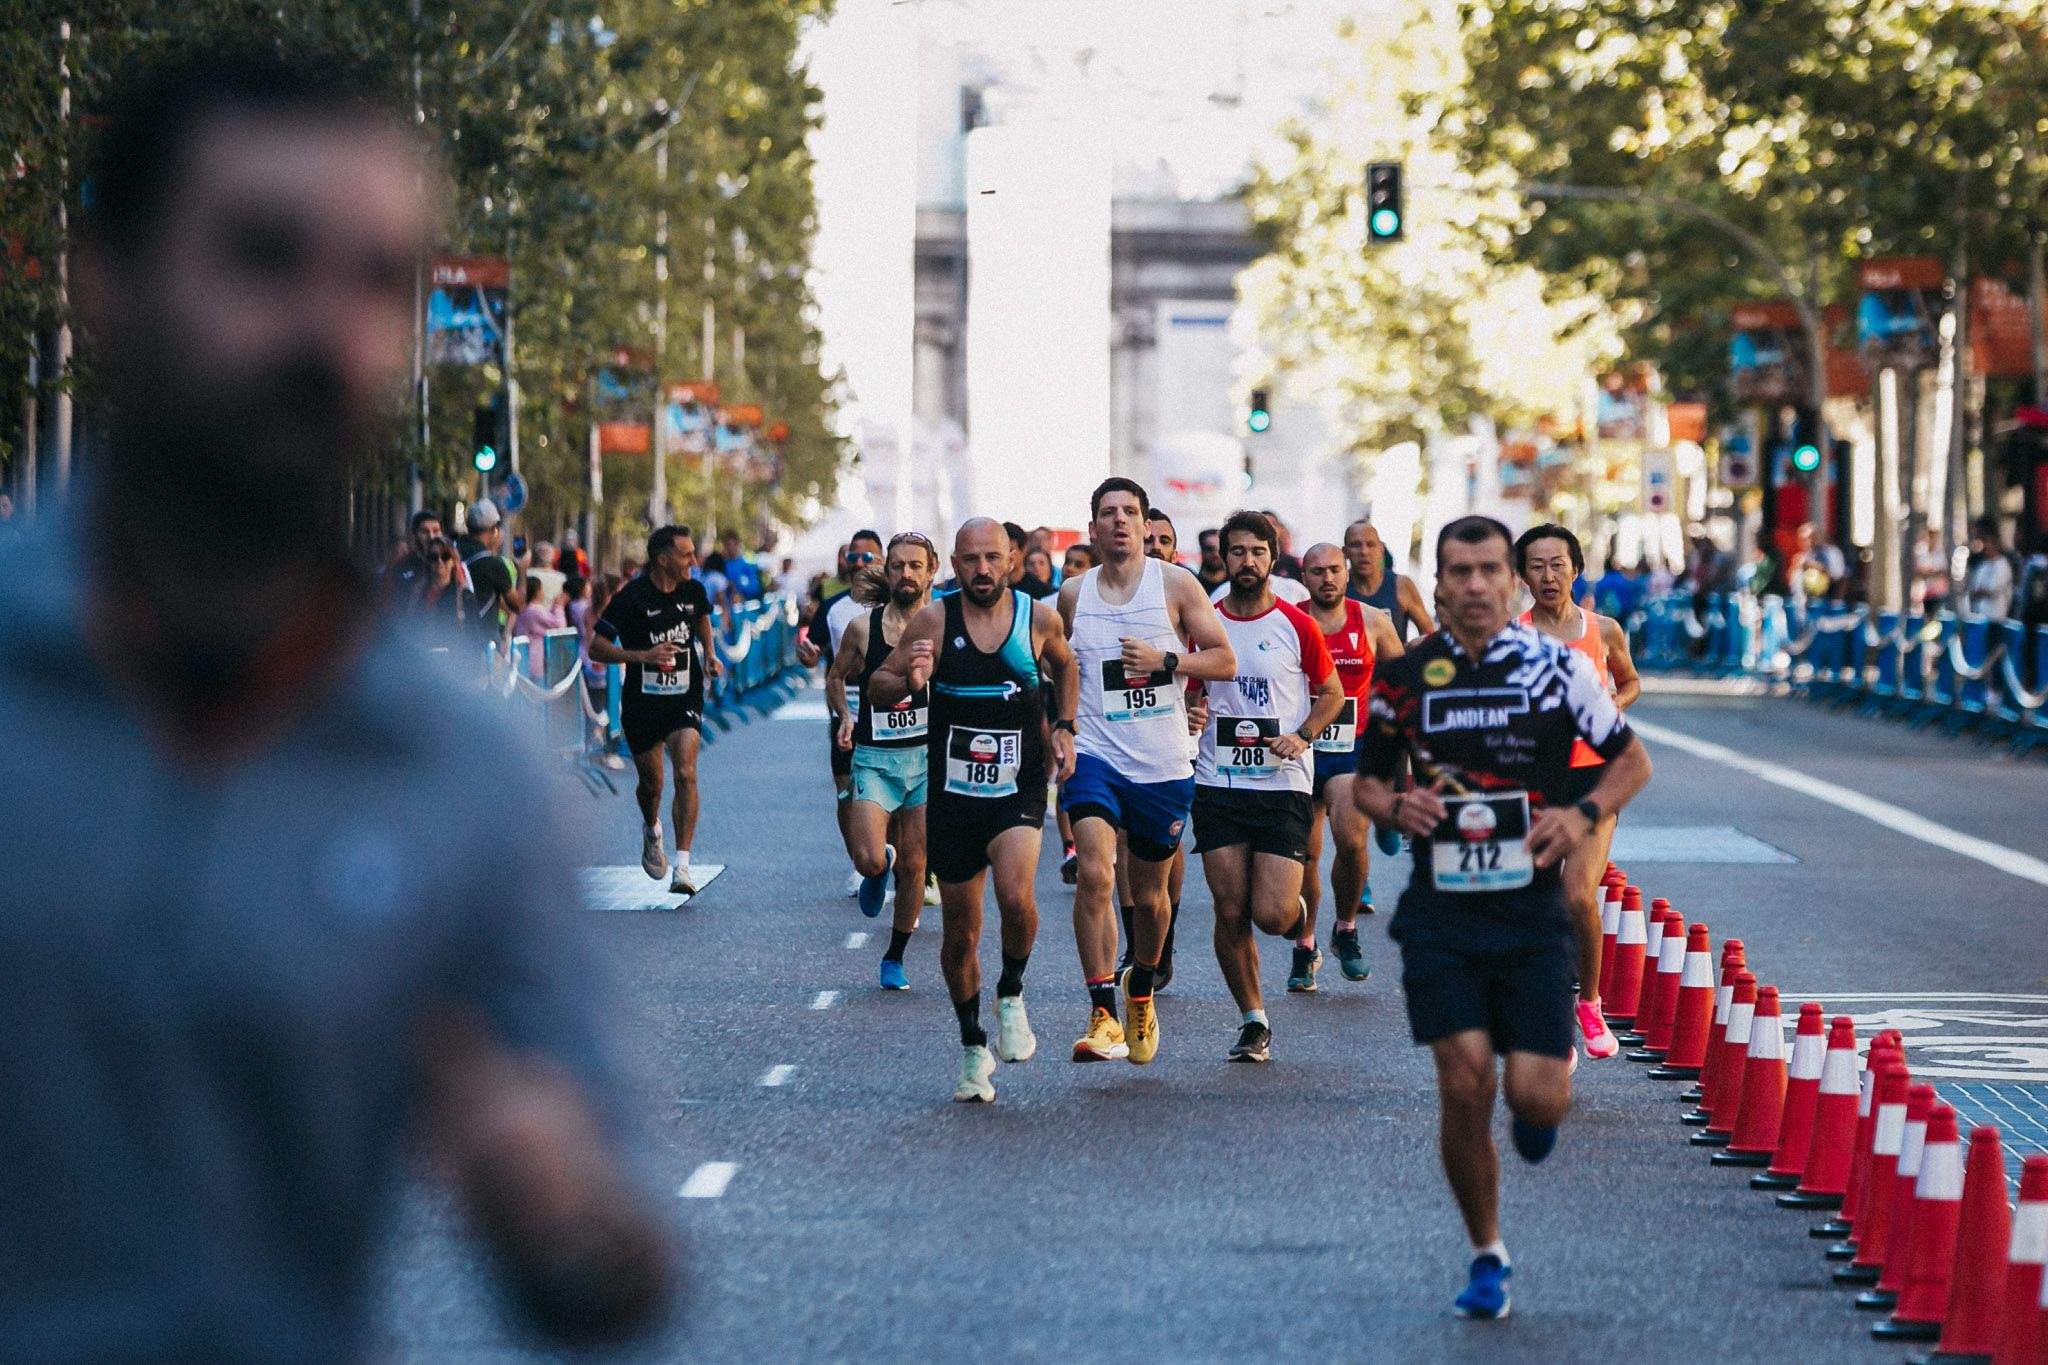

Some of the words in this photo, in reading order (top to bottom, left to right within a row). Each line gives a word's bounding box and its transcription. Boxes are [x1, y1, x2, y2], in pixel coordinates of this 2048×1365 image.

[656, 672, 678, 685] 475
[1123, 688, 1157, 709] 195
[887, 710, 917, 728] 603
[1318, 725, 1340, 741] 87
[1003, 739, 1014, 764] 3206
[1232, 747, 1265, 766] 208
[965, 763, 999, 785] 189
[1459, 842, 1503, 872] 212
